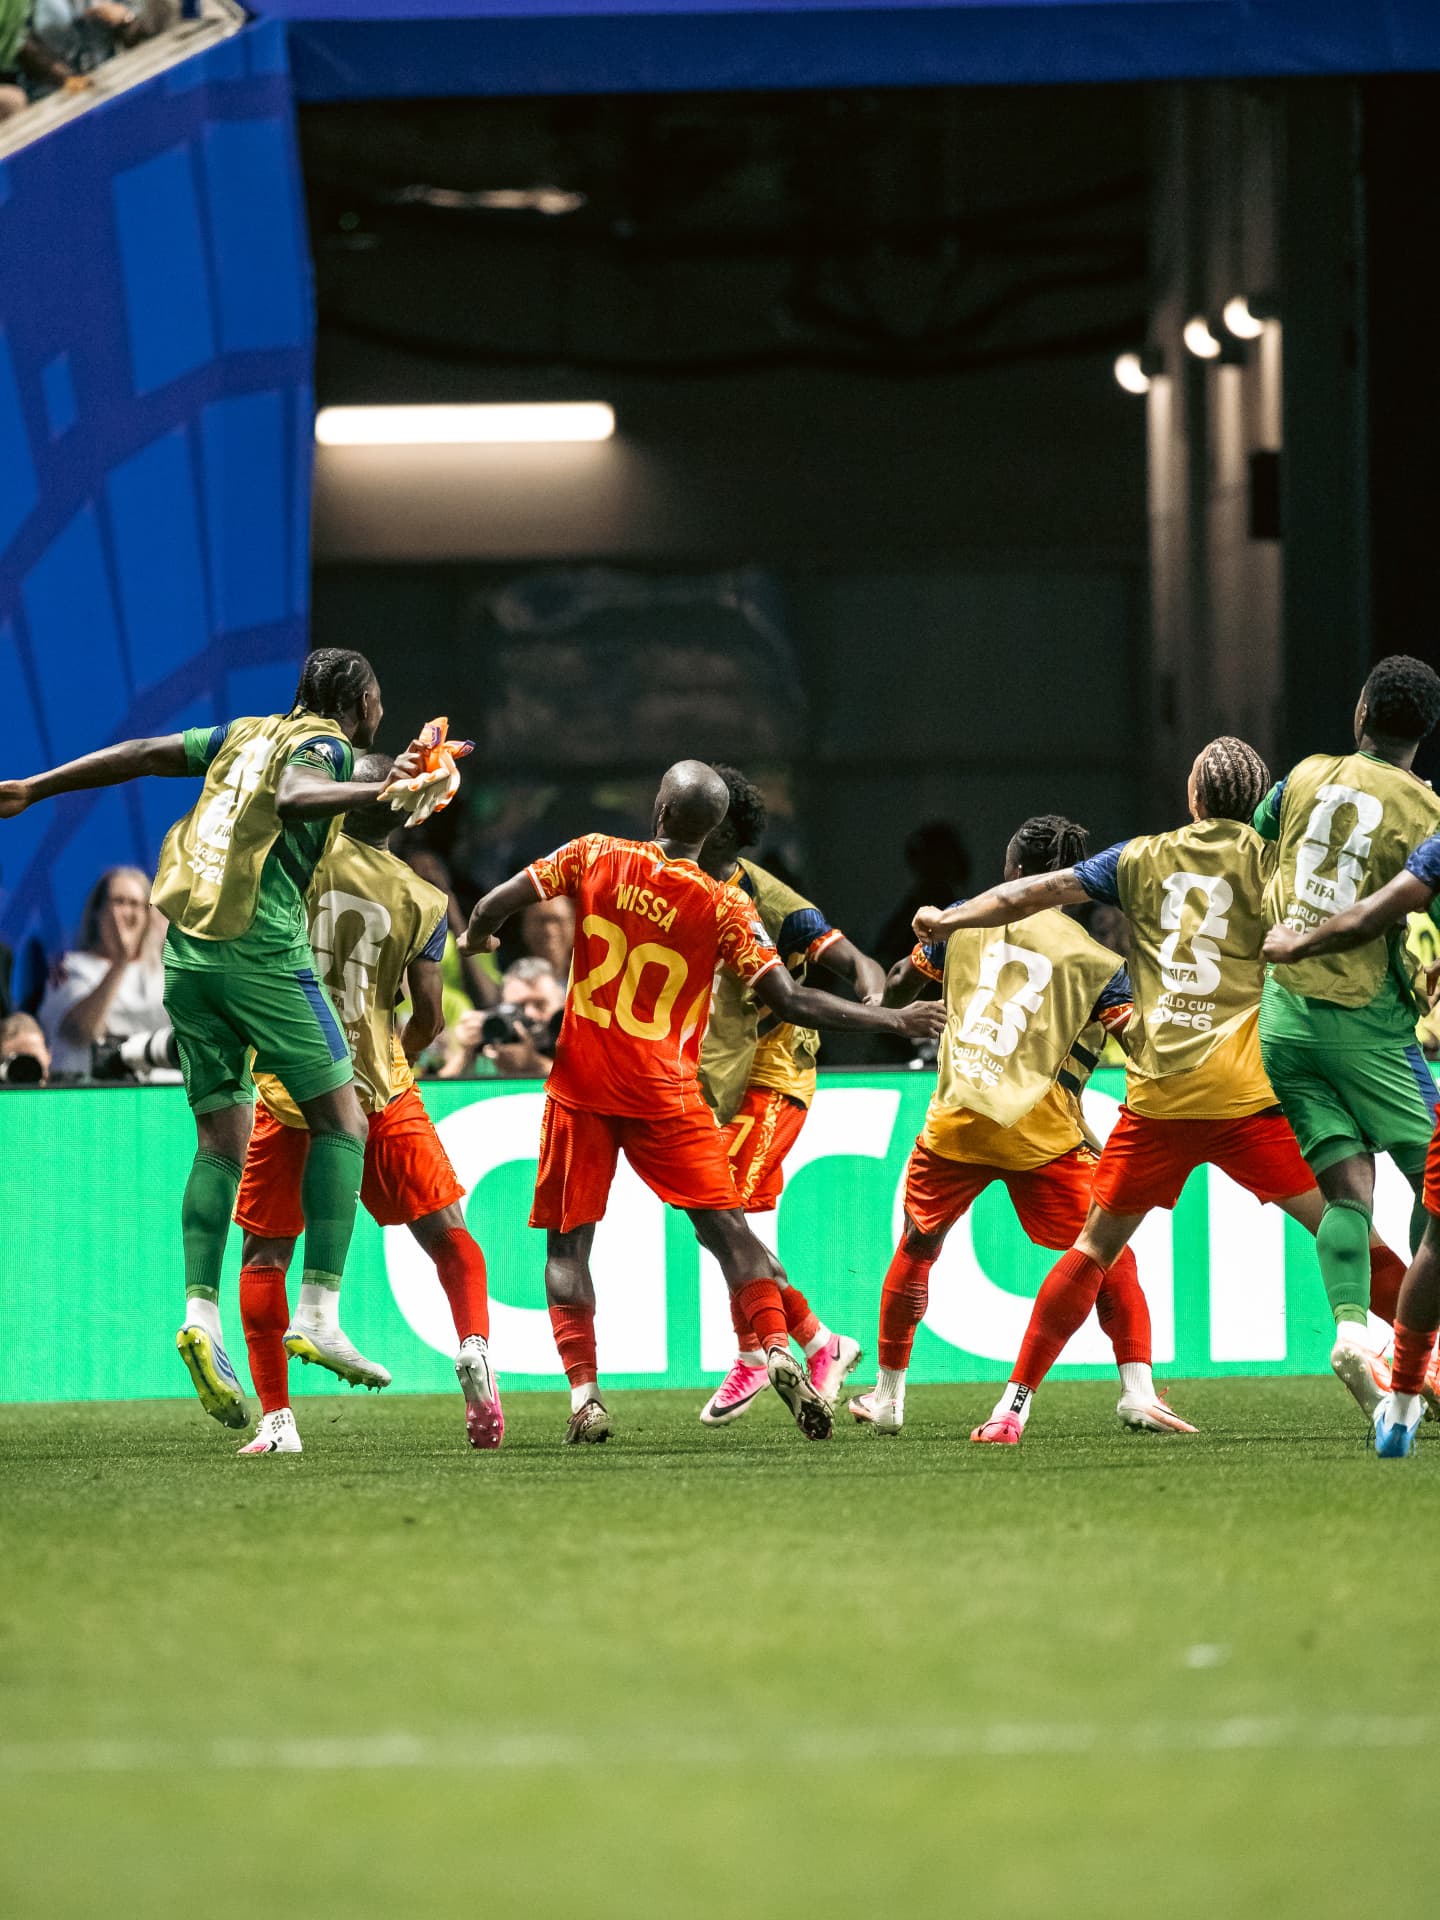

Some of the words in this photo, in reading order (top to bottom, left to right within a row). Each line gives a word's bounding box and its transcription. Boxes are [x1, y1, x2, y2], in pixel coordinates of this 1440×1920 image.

[1305, 879, 1335, 901] FIFA
[616, 884, 678, 933] WISSA
[572, 914, 689, 1041] 20
[1188, 1000, 1216, 1012] CUP
[970, 1022, 999, 1042] FIFA
[982, 1053, 1004, 1074] CUP
